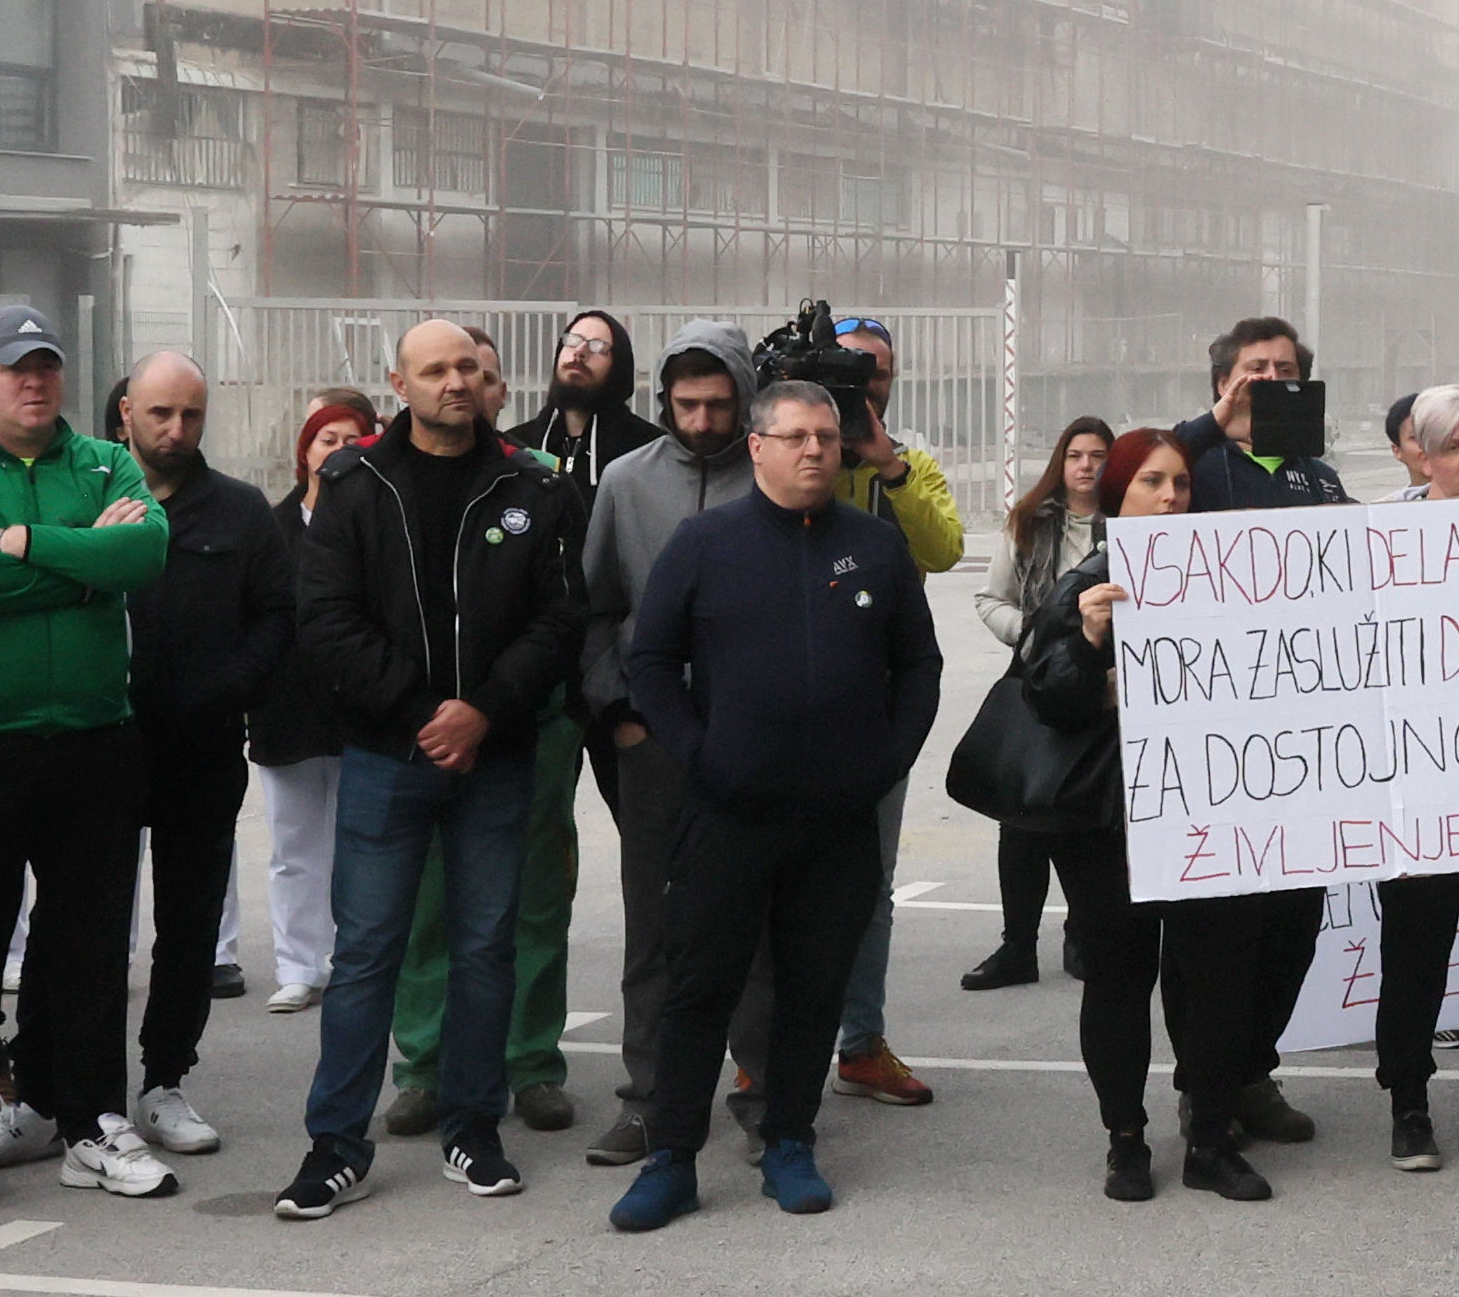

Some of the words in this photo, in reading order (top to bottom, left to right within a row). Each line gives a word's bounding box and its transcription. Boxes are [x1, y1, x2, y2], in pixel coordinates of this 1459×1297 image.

[1121, 635, 1239, 709] MORA
[1246, 610, 1426, 700] ZASLUŽITI
[1126, 736, 1190, 823] ZA
